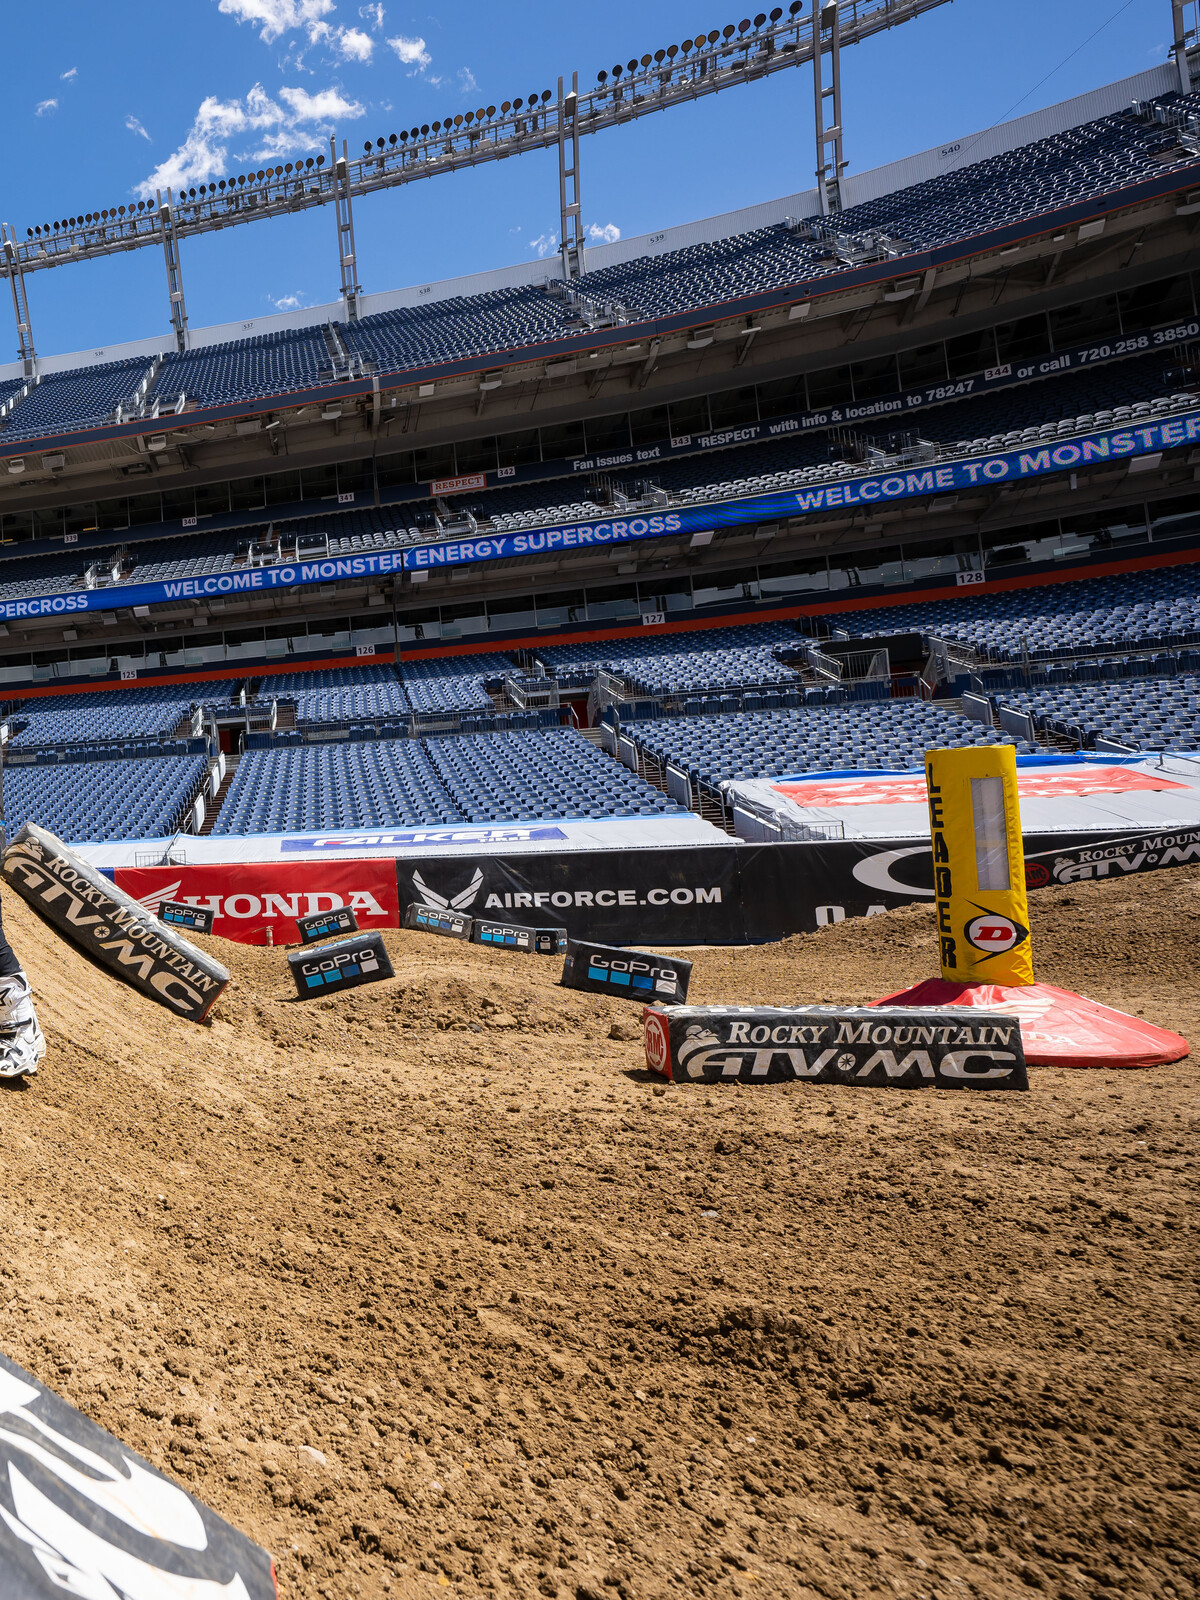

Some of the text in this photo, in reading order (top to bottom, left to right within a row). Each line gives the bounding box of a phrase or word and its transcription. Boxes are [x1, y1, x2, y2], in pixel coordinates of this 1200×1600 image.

[941, 144, 961, 157] 540
[649, 234, 665, 244] 539
[418, 287, 431, 295] 538
[986, 366, 1010, 379] 344
[573, 459, 593, 471] Fan
[596, 454, 633, 467] issues
[636, 447, 661, 460] text
[769, 419, 798, 435] with
[801, 413, 827, 428] info
[830, 410, 842, 421] &
[846, 399, 902, 419] location
[905, 393, 922, 406] to
[926, 380, 975, 402] 78247
[1016, 366, 1035, 379] or
[1039, 355, 1070, 374] call
[1077, 336, 1149, 363] 720.258
[1152, 323, 1199, 344] 3850
[672, 437, 690, 446] 343
[795, 417, 1200, 510] WELCOME TO MONSTER
[499, 467, 514, 476] 342
[435, 476, 482, 491] RESPECT
[339, 494, 353, 502] 341
[183, 518, 197, 526] 340
[65, 534, 77, 542] 339
[163, 513, 682, 598] WELCOME TO MONSTER ENERGY SUPERCROSS
[958, 572, 983, 583] 128
[645, 613, 664, 624] 127
[358, 645, 374, 655] 126
[122, 670, 136, 679] 125
[1078, 844, 1137, 863] ROCKY
[927, 763, 957, 969] LEADER
[1058, 852, 1148, 884] ATV
[484, 887, 723, 908] AIRFORCE.COM
[164, 905, 206, 919] GoPro
[183, 891, 388, 919] HONDA
[304, 913, 348, 930] GoPro
[417, 907, 464, 925] GoPro
[44, 855, 219, 992] ROCKY MOUNTAIN
[481, 925, 529, 939] GoPro
[301, 949, 375, 976] GoPro
[589, 954, 678, 981] GoPro
[724, 1021, 829, 1045] ROCKY
[833, 1021, 1014, 1046] MOUNTAIN
